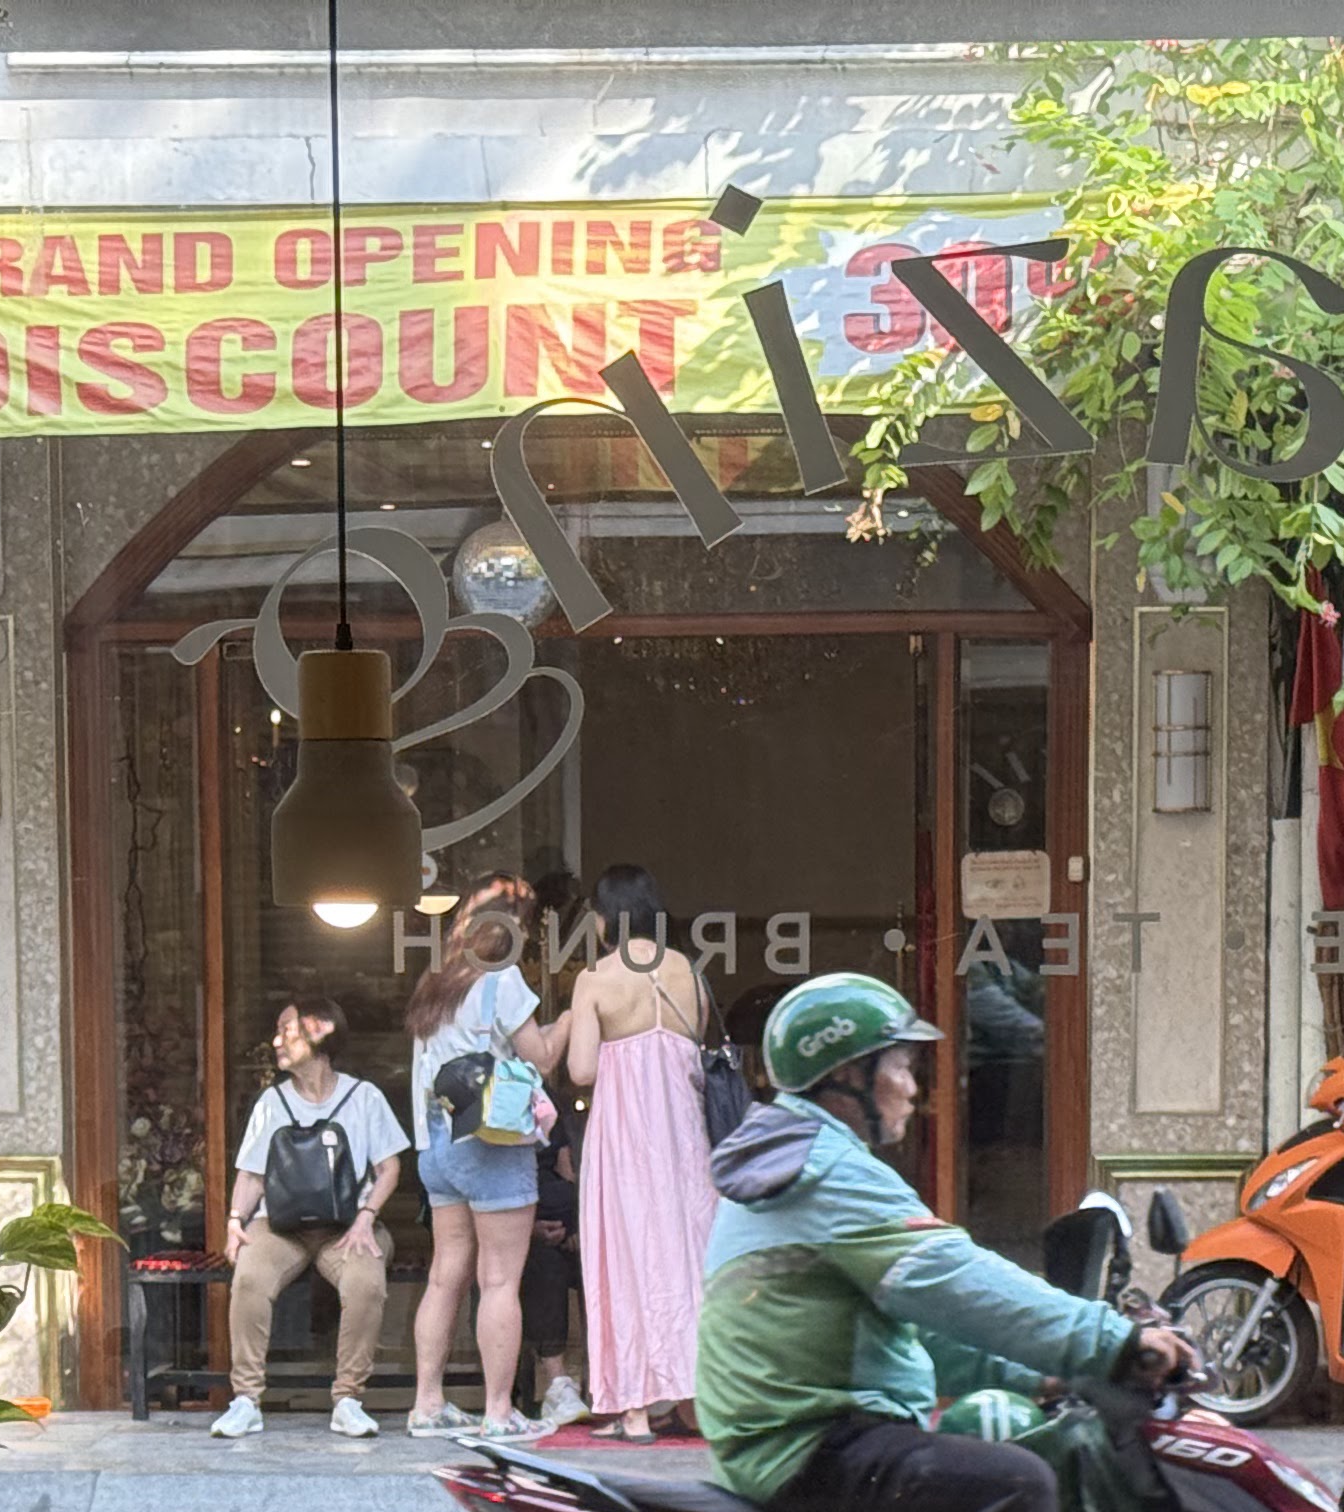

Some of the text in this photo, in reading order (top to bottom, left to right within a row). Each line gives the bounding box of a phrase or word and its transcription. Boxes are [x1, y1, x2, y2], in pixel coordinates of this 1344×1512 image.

[274, 219, 723, 290] OPENING
[797, 1015, 857, 1058] Grab
[1150, 1433, 1254, 1468] 160
